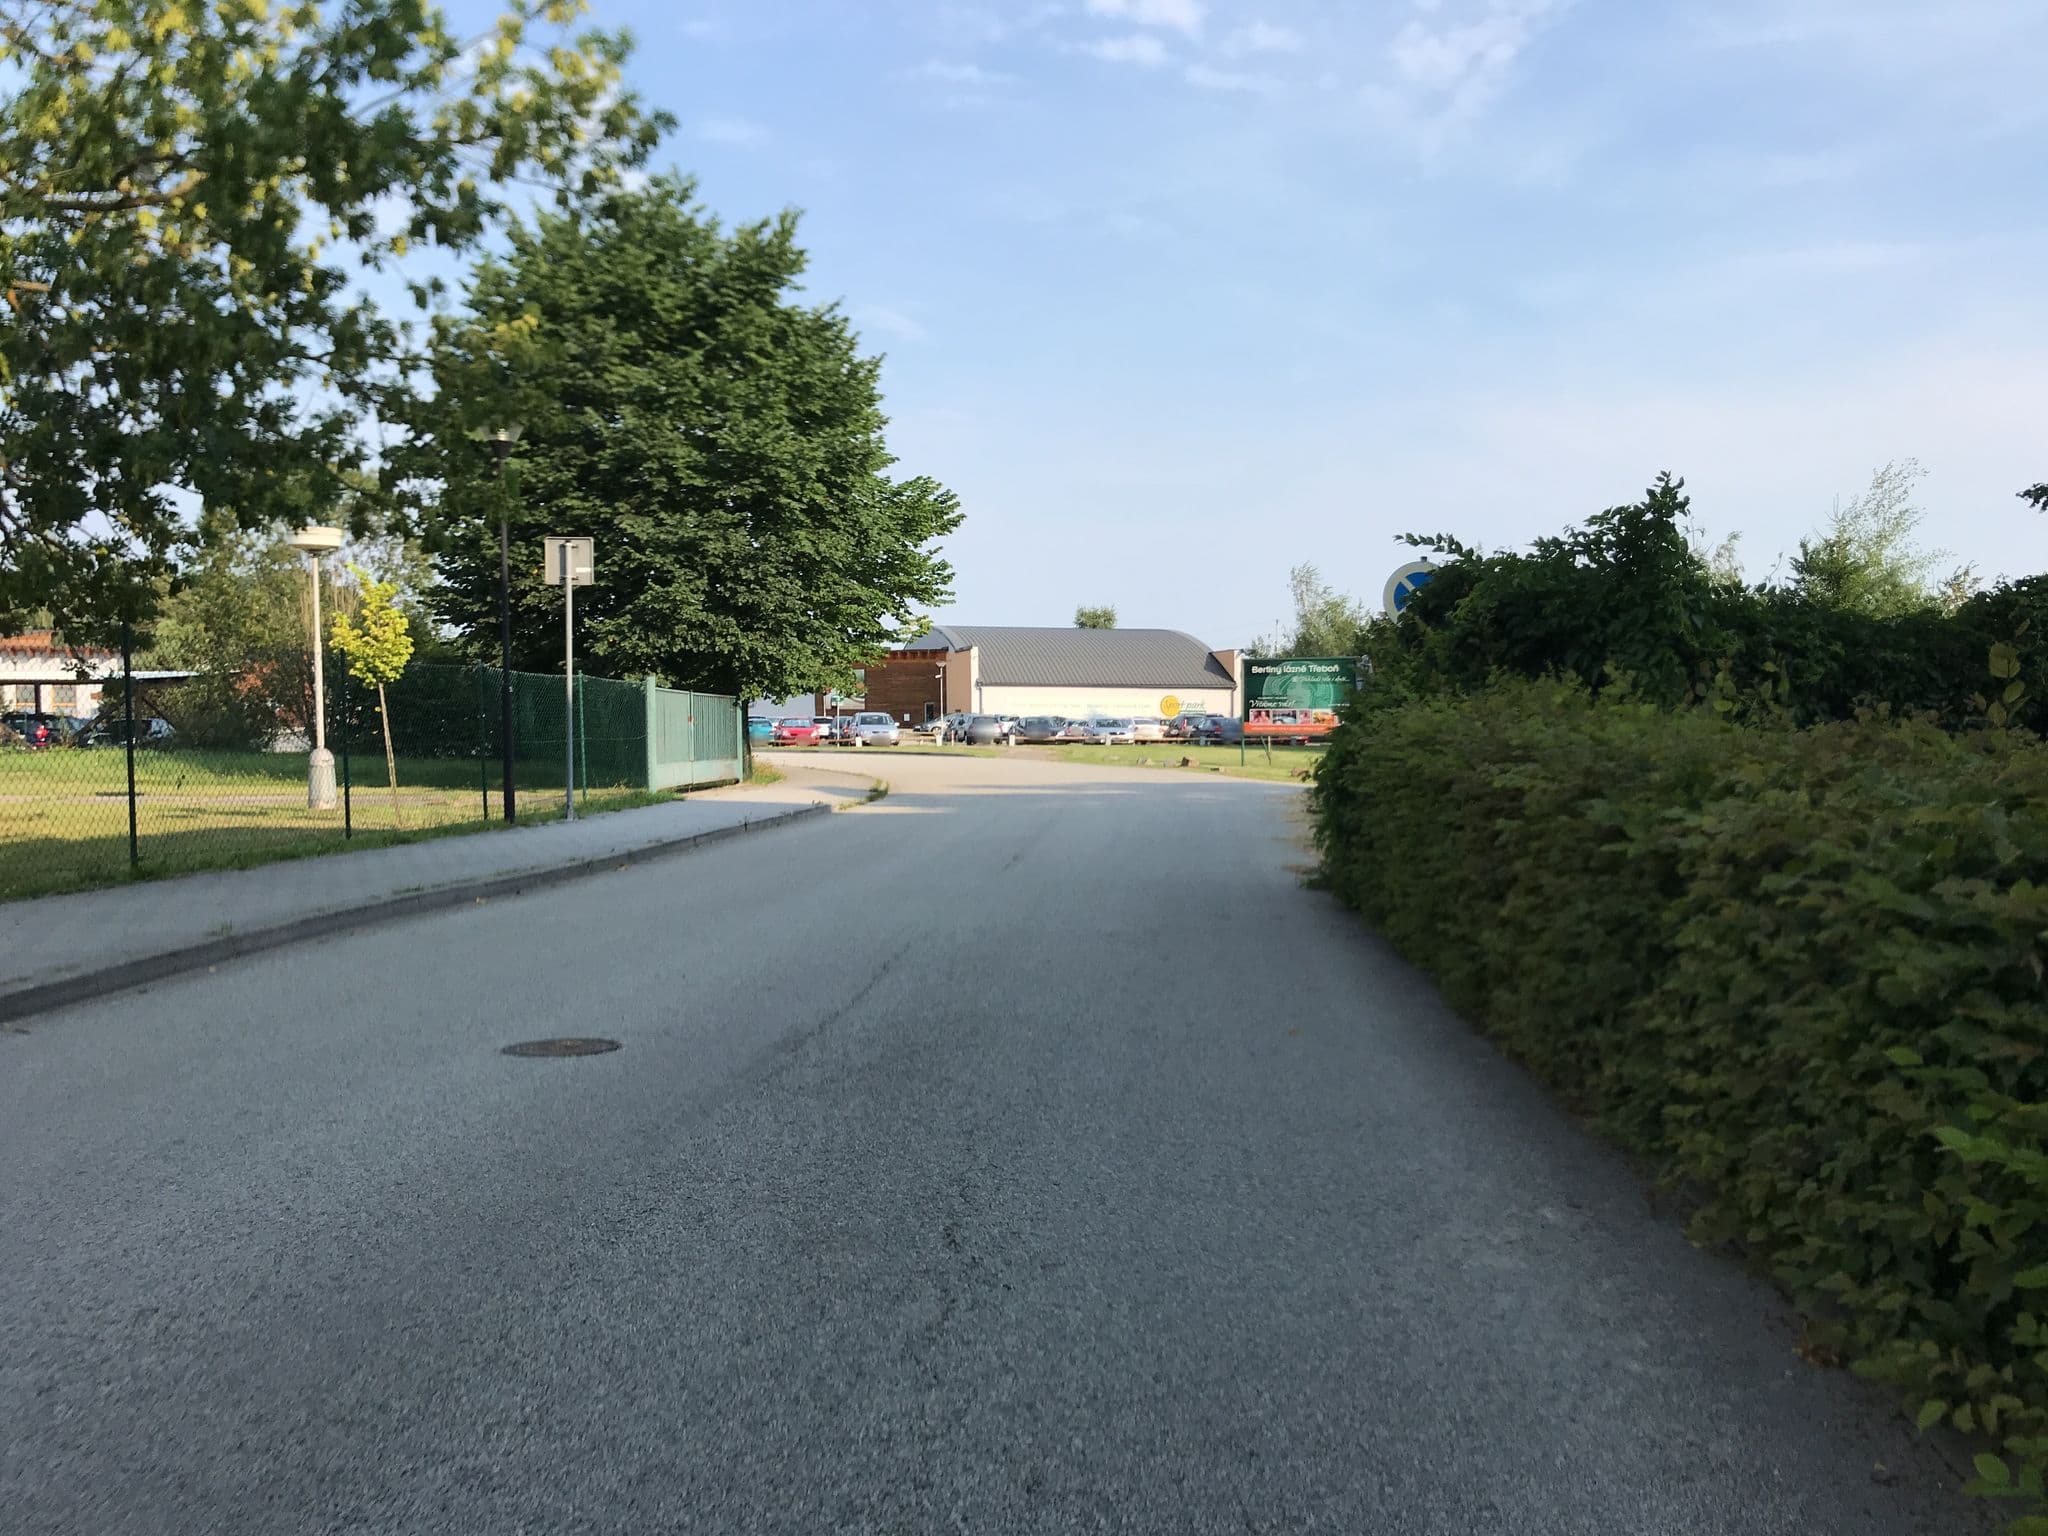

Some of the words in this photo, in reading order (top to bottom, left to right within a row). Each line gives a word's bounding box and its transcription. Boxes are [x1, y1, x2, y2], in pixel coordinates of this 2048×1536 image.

[1251, 665, 1282, 675] Bertiny
[1283, 665, 1307, 673] lázně
[1308, 664, 1340, 673] Třeboň
